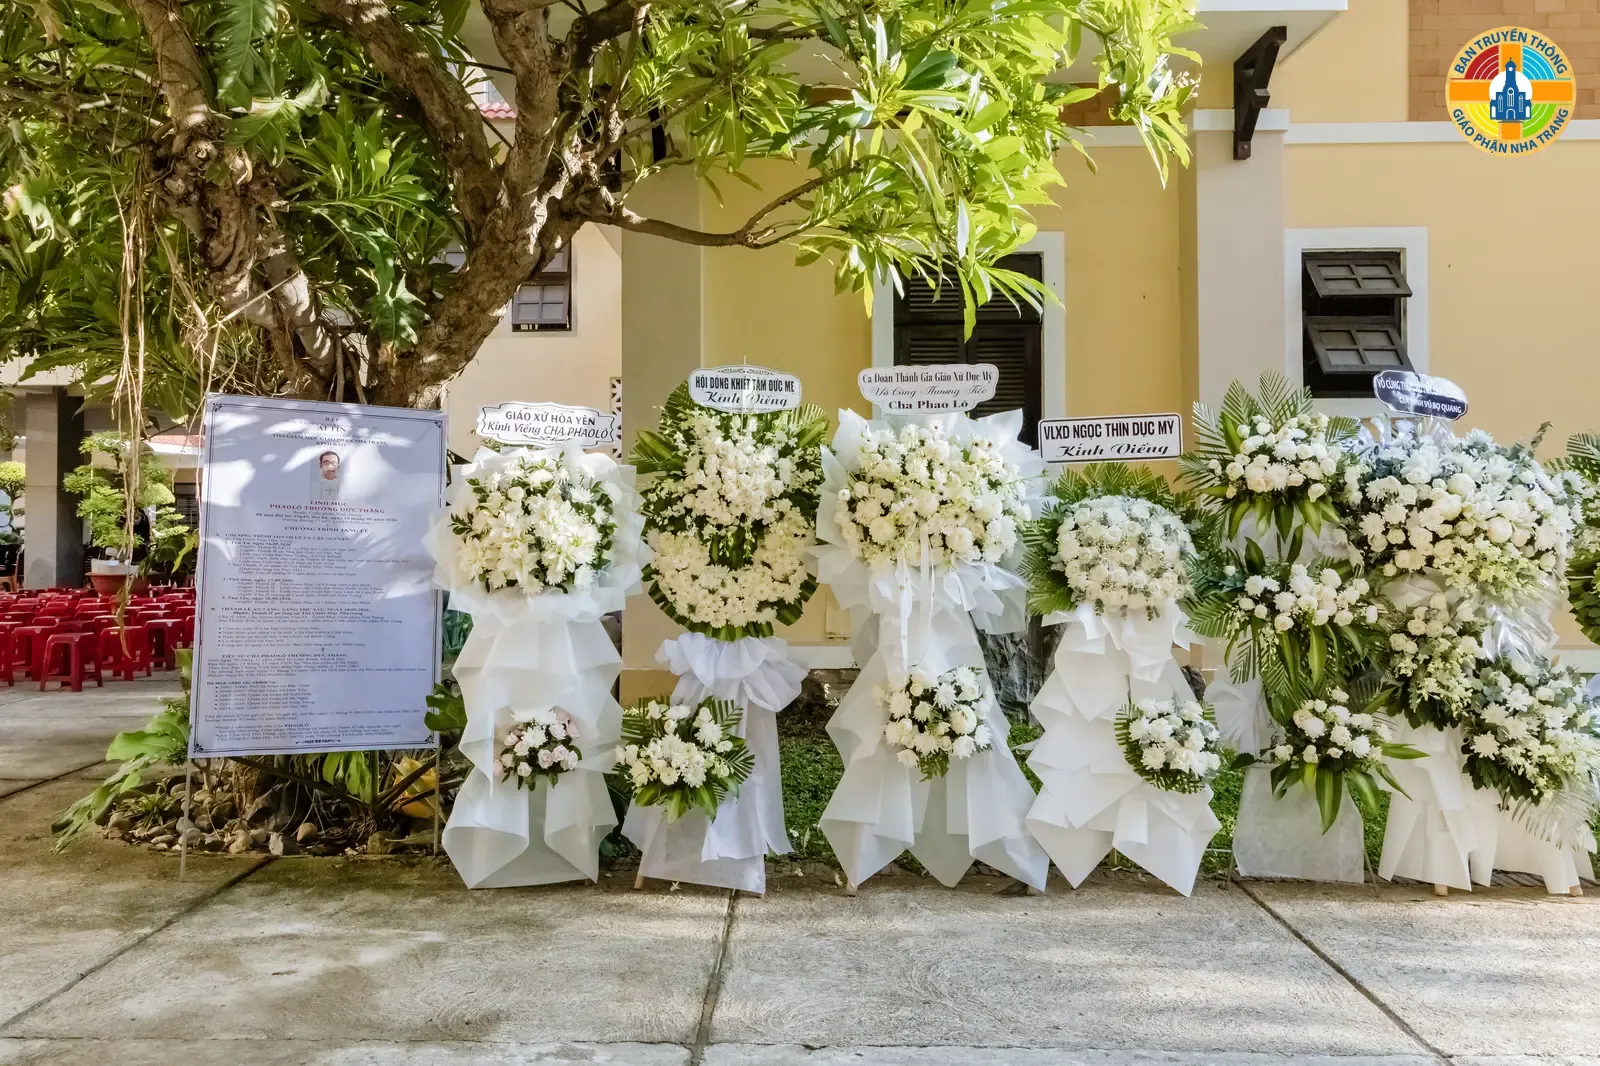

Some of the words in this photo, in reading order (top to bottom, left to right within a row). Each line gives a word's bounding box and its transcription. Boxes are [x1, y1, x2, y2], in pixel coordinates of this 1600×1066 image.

[862, 374, 872, 384] Ca
[895, 371, 919, 383] Thánh
[920, 371, 933, 382] Gia
[935, 371, 951, 382] Giáo
[953, 371, 964, 382] Xứ
[784, 380, 795, 395] MẸ
[888, 400, 913, 410] Cha
[917, 400, 949, 409] Phao
[953, 399, 968, 408] Lô
[1441, 404, 1462, 413] QUANG
[505, 410, 531, 421] GIÁO
[533, 411, 549, 422] XỨ
[551, 413, 573, 425] HÒA
[575, 415, 596, 426] YÊN
[487, 421, 511, 432] Kính
[514, 422, 540, 436] Viếng
[543, 425, 565, 436] CHA
[567, 427, 609, 439] PHAOLÔ
[1044, 425, 1070, 440] VLXD
[1073, 424, 1102, 440] NGỌC
[1133, 421, 1155, 438] DỤC
[1057, 443, 1104, 457] Kính
[1111, 443, 1169, 456] Viếng
